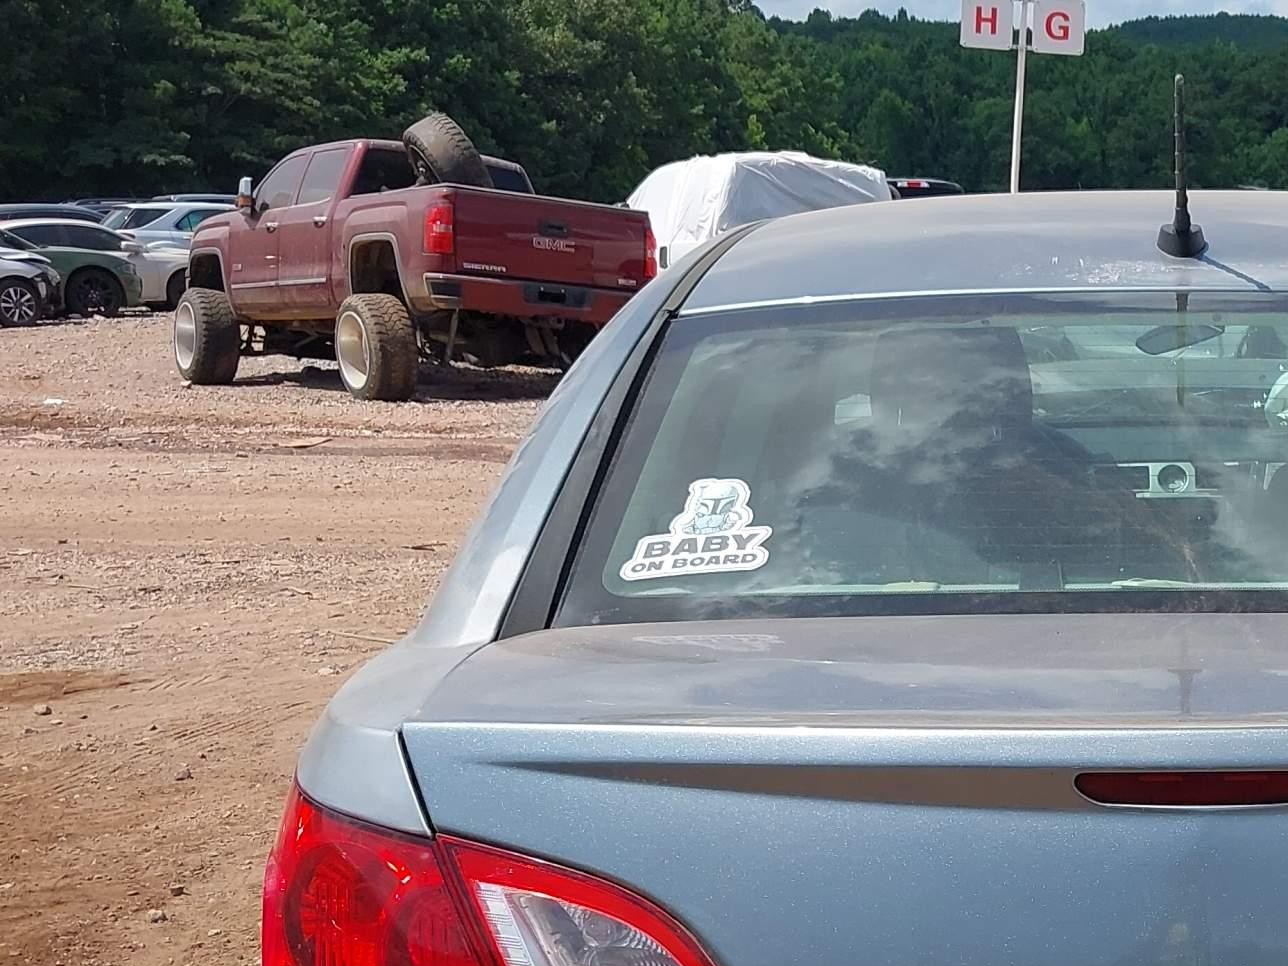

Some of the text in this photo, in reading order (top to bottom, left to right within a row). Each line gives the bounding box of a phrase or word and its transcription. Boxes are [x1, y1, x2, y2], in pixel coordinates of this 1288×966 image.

[975, 6, 997, 35] H
[1045, 11, 1070, 41] G
[532, 236, 576, 253] GMC
[463, 261, 507, 273] SIERRA
[643, 533, 761, 559] BABY
[631, 553, 758, 573] ON BOARD
